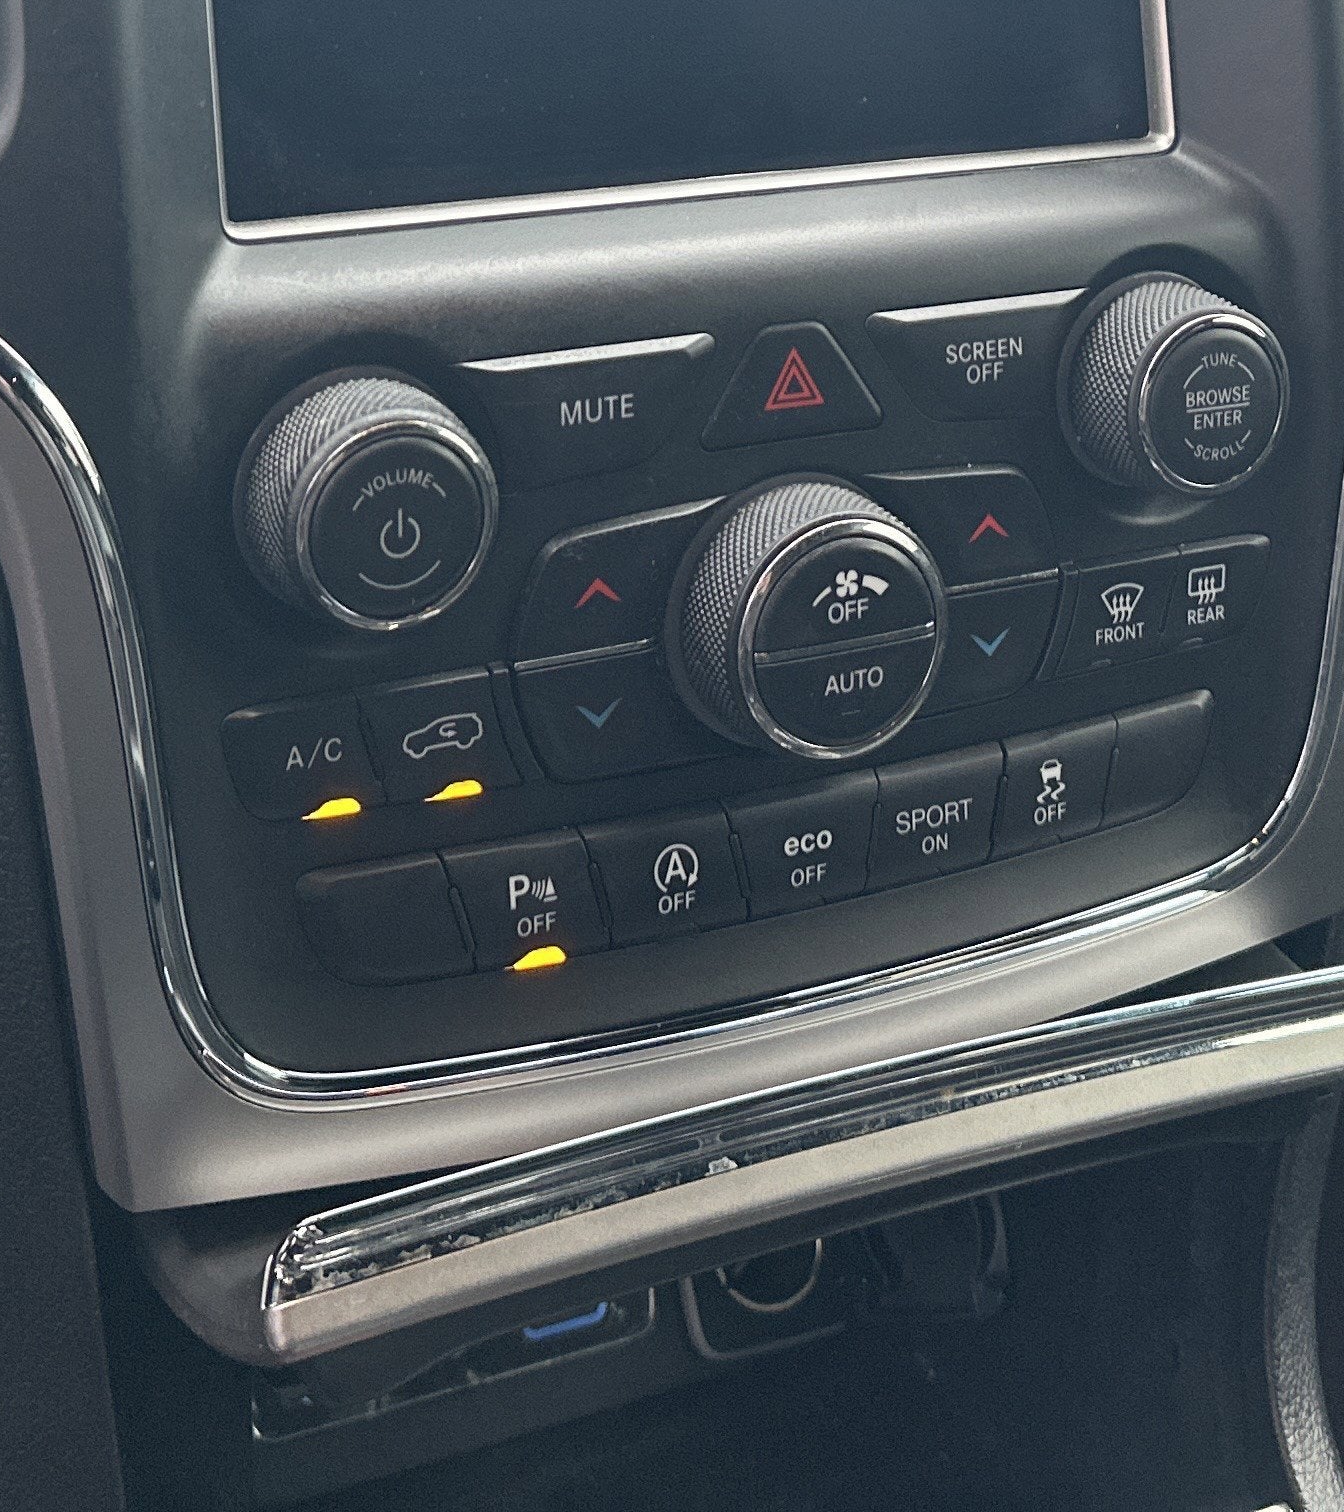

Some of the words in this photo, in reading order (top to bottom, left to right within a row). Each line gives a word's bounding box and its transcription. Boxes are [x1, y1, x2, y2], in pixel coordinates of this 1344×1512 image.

[945, 336, 1024, 364] SCREEN
[1201, 352, 1239, 369] TUNE
[966, 361, 1005, 385] OFF
[1185, 384, 1251, 408] BROWSE
[560, 393, 635, 427] MUTE
[1193, 410, 1243, 431] ENTER
[1193, 439, 1246, 461] SCROLL
[361, 467, 435, 499] VOLUME
[827, 597, 870, 624] OFF
[1186, 604, 1226, 625] REAR
[1095, 621, 1146, 645] FRONT
[824, 665, 884, 697] AUTO
[285, 736, 344, 772] A/C
[895, 797, 974, 834] SPORT
[1033, 801, 1068, 826] OFF
[783, 829, 833, 856] eco
[921, 832, 950, 855] ON
[790, 863, 828, 888] OFF
[657, 890, 697, 915] OFF
[516, 911, 558, 938] OFF
